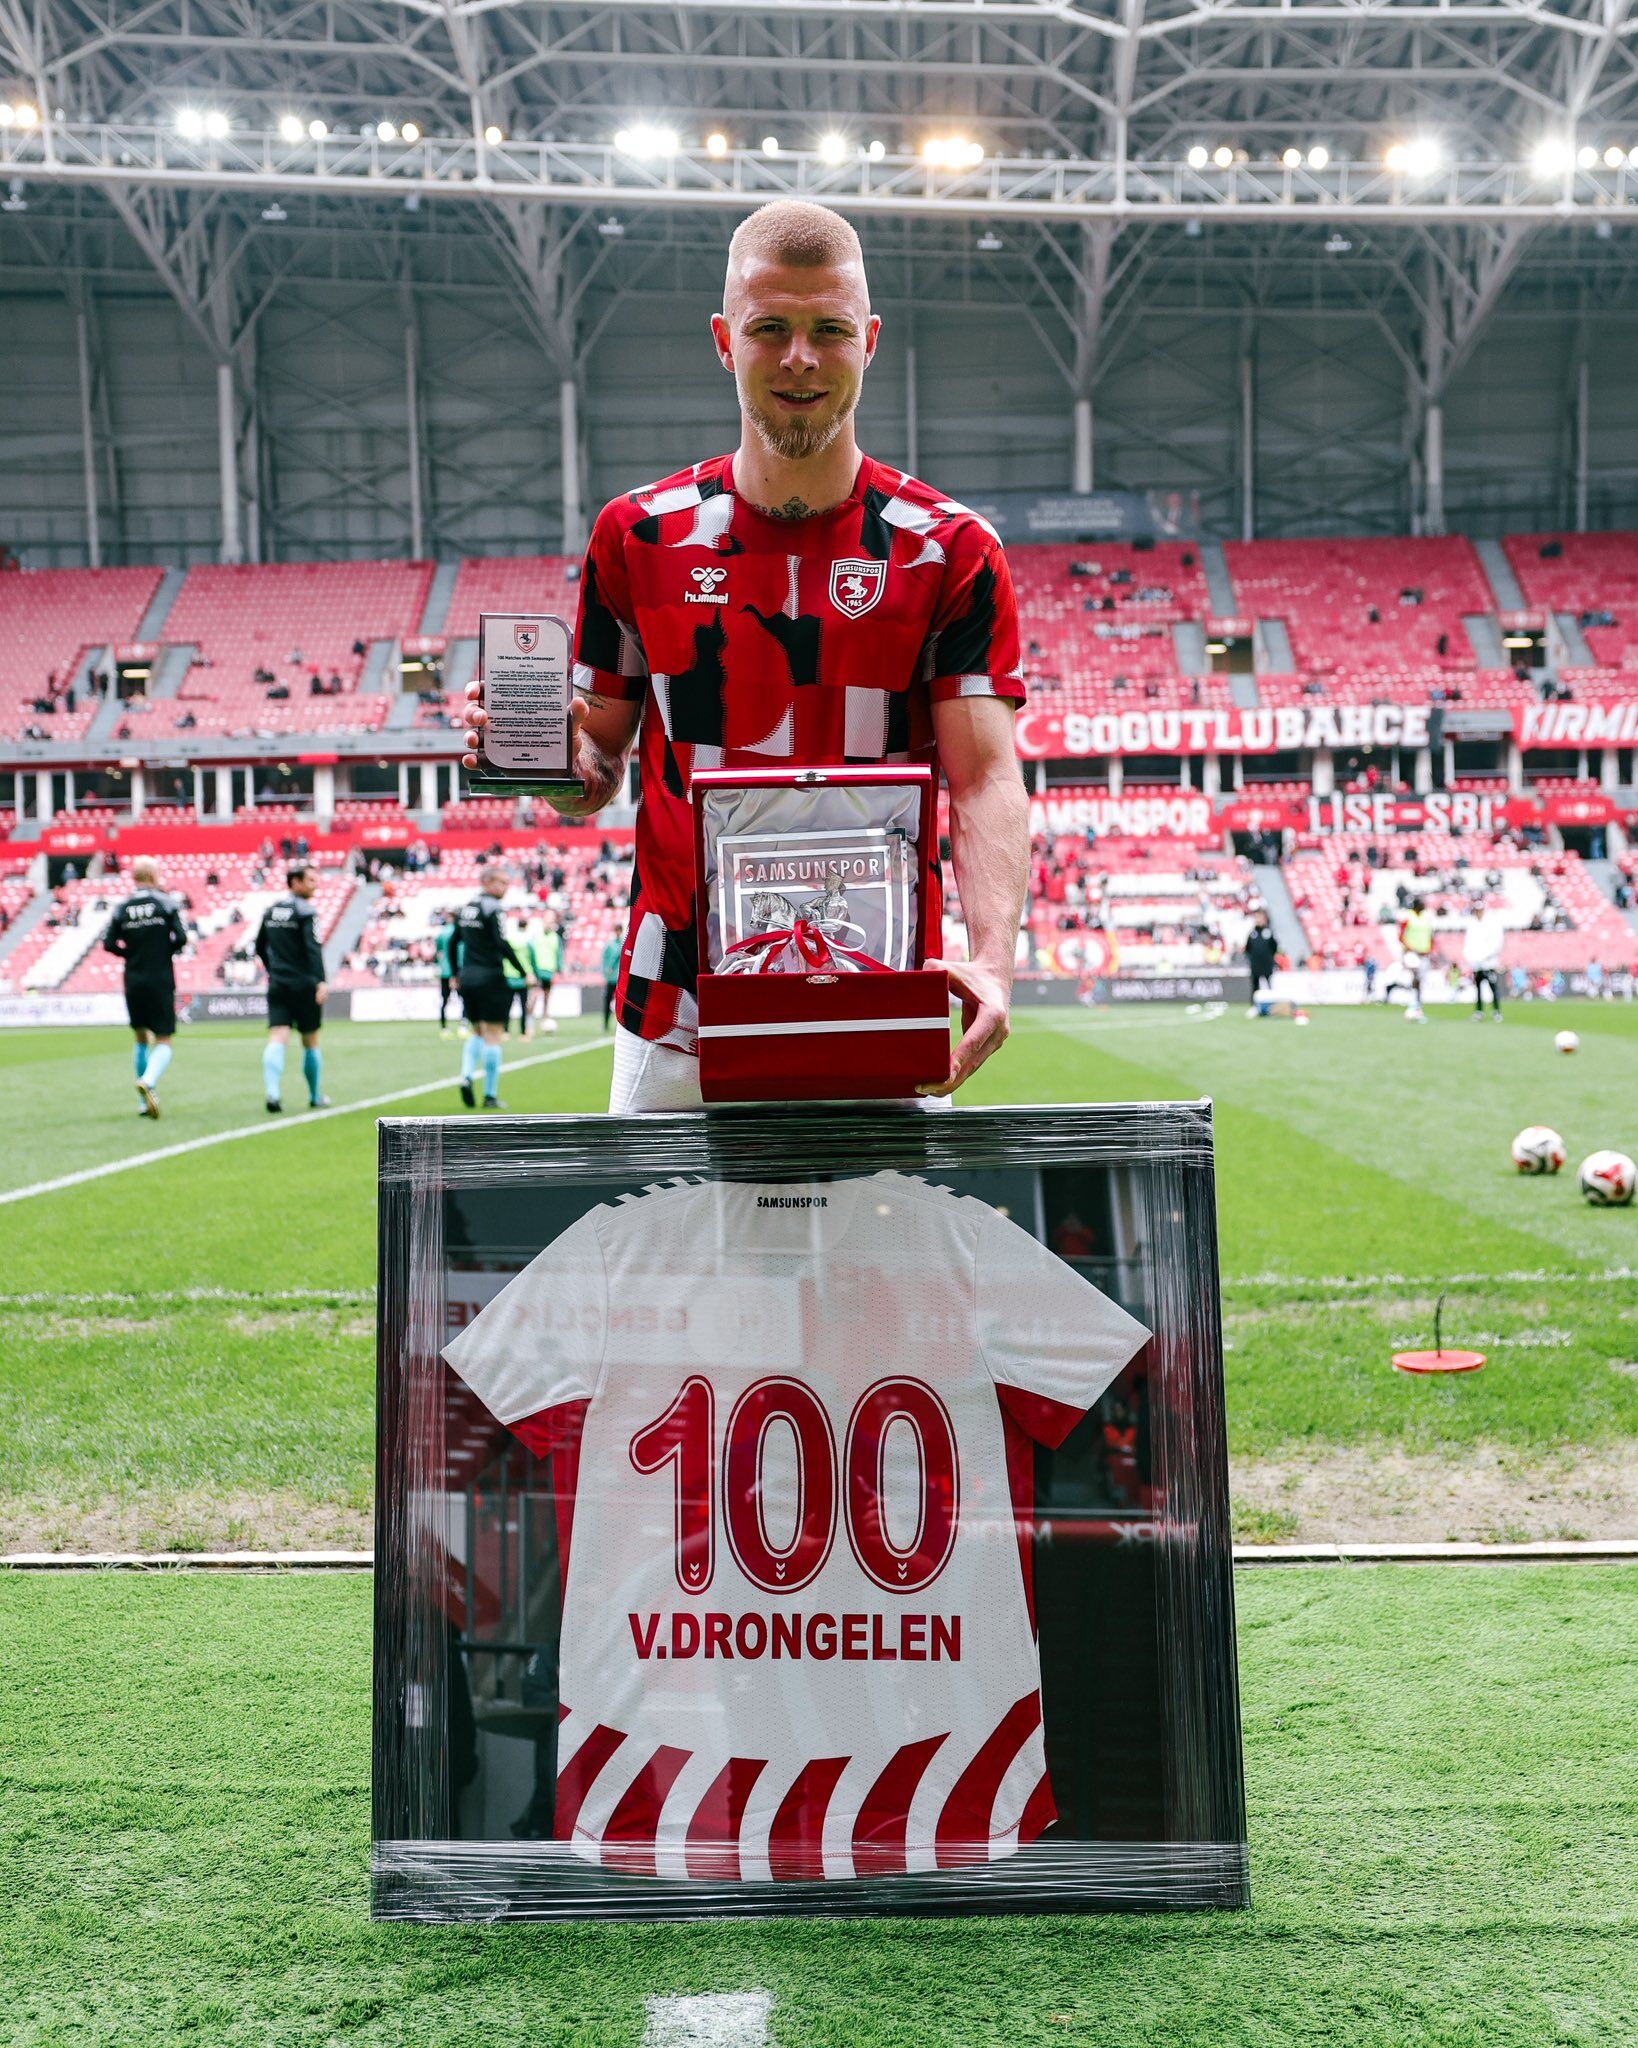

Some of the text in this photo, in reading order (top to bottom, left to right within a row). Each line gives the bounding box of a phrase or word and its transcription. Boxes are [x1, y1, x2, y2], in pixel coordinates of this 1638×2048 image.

[837, 566, 880, 574] SAMSUNSPOR
[684, 590, 729, 604] hummel
[846, 599, 863, 607] 1965
[1521, 703, 1638, 743] KIRMI
[1029, 797, 1210, 837] AMSUNSPOR
[744, 858, 880, 883] SAMSUNSPOR
[757, 1196, 828, 1209] SAMSUNSPOR
[629, 1375, 960, 1596] 100
[628, 1612, 961, 1662] V.DRONGELEN
